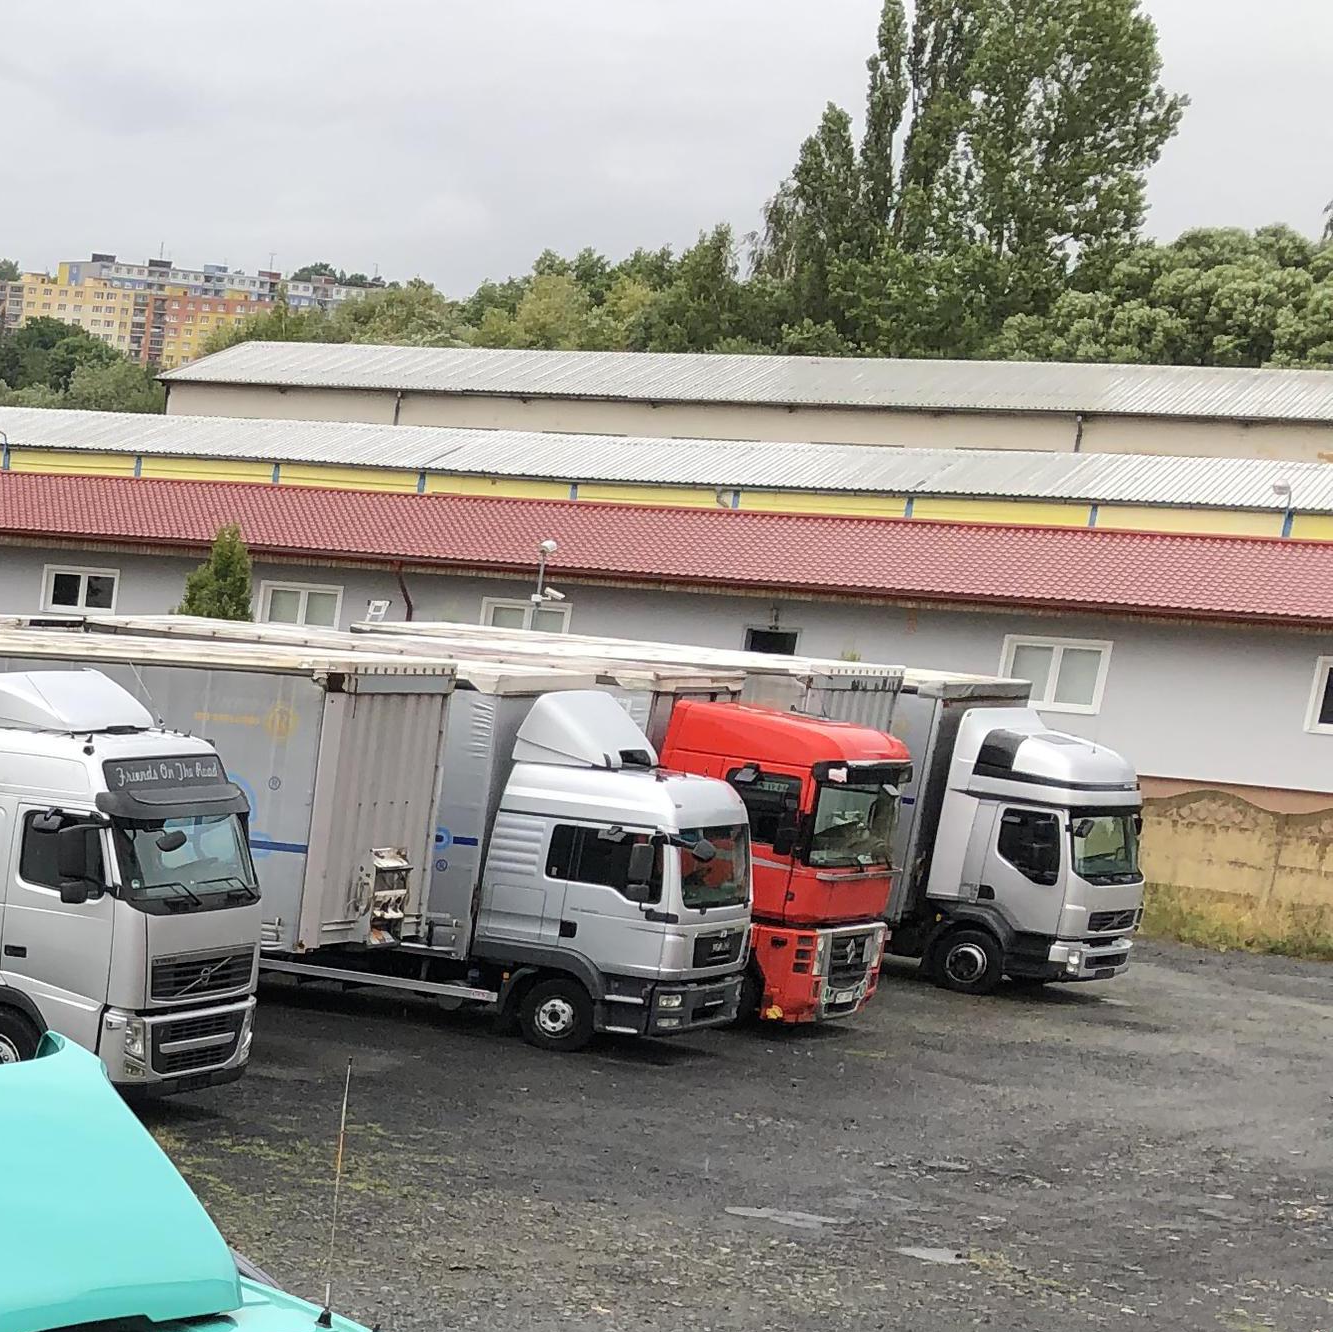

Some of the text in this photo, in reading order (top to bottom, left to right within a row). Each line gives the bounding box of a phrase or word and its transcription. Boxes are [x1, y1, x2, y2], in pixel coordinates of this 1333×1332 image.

[115, 762, 218, 787] Friends On The Road
